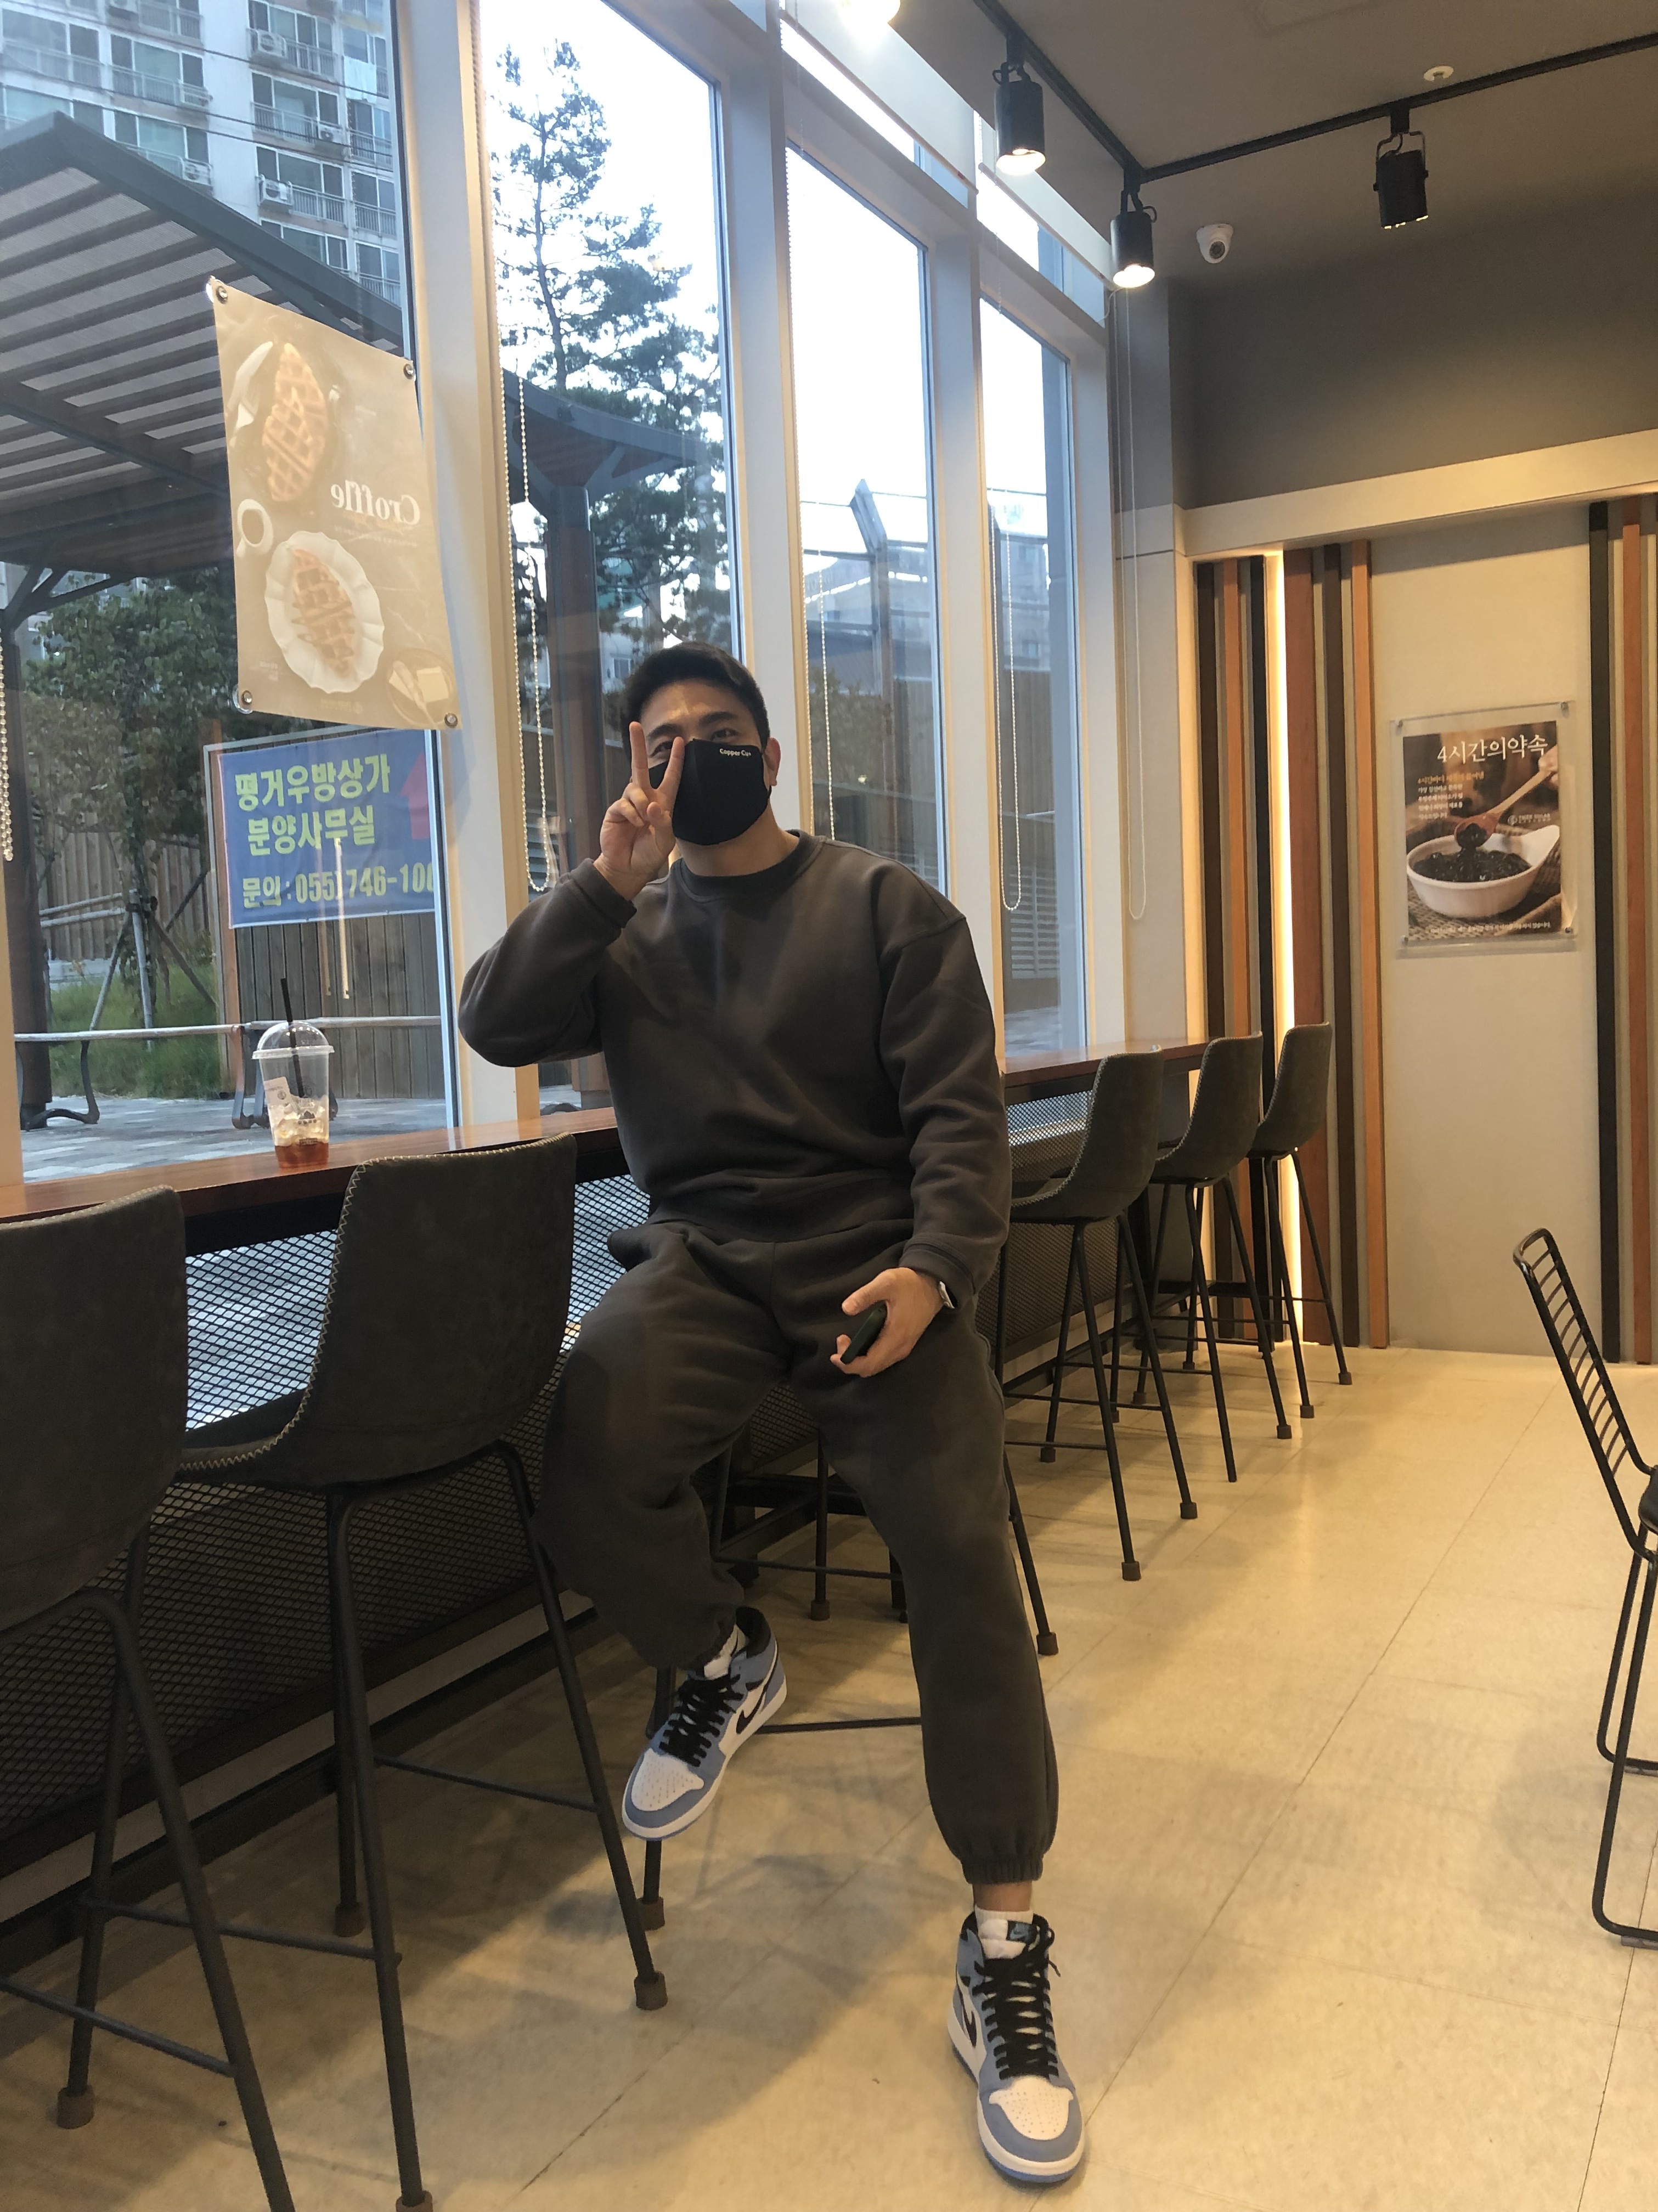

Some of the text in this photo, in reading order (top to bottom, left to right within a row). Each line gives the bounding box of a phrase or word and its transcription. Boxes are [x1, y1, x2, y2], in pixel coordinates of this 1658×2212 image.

[719, 748, 740, 757] Copper
[235, 753, 390, 811] 평거우방상가
[247, 804, 375, 856] 분양사무실
